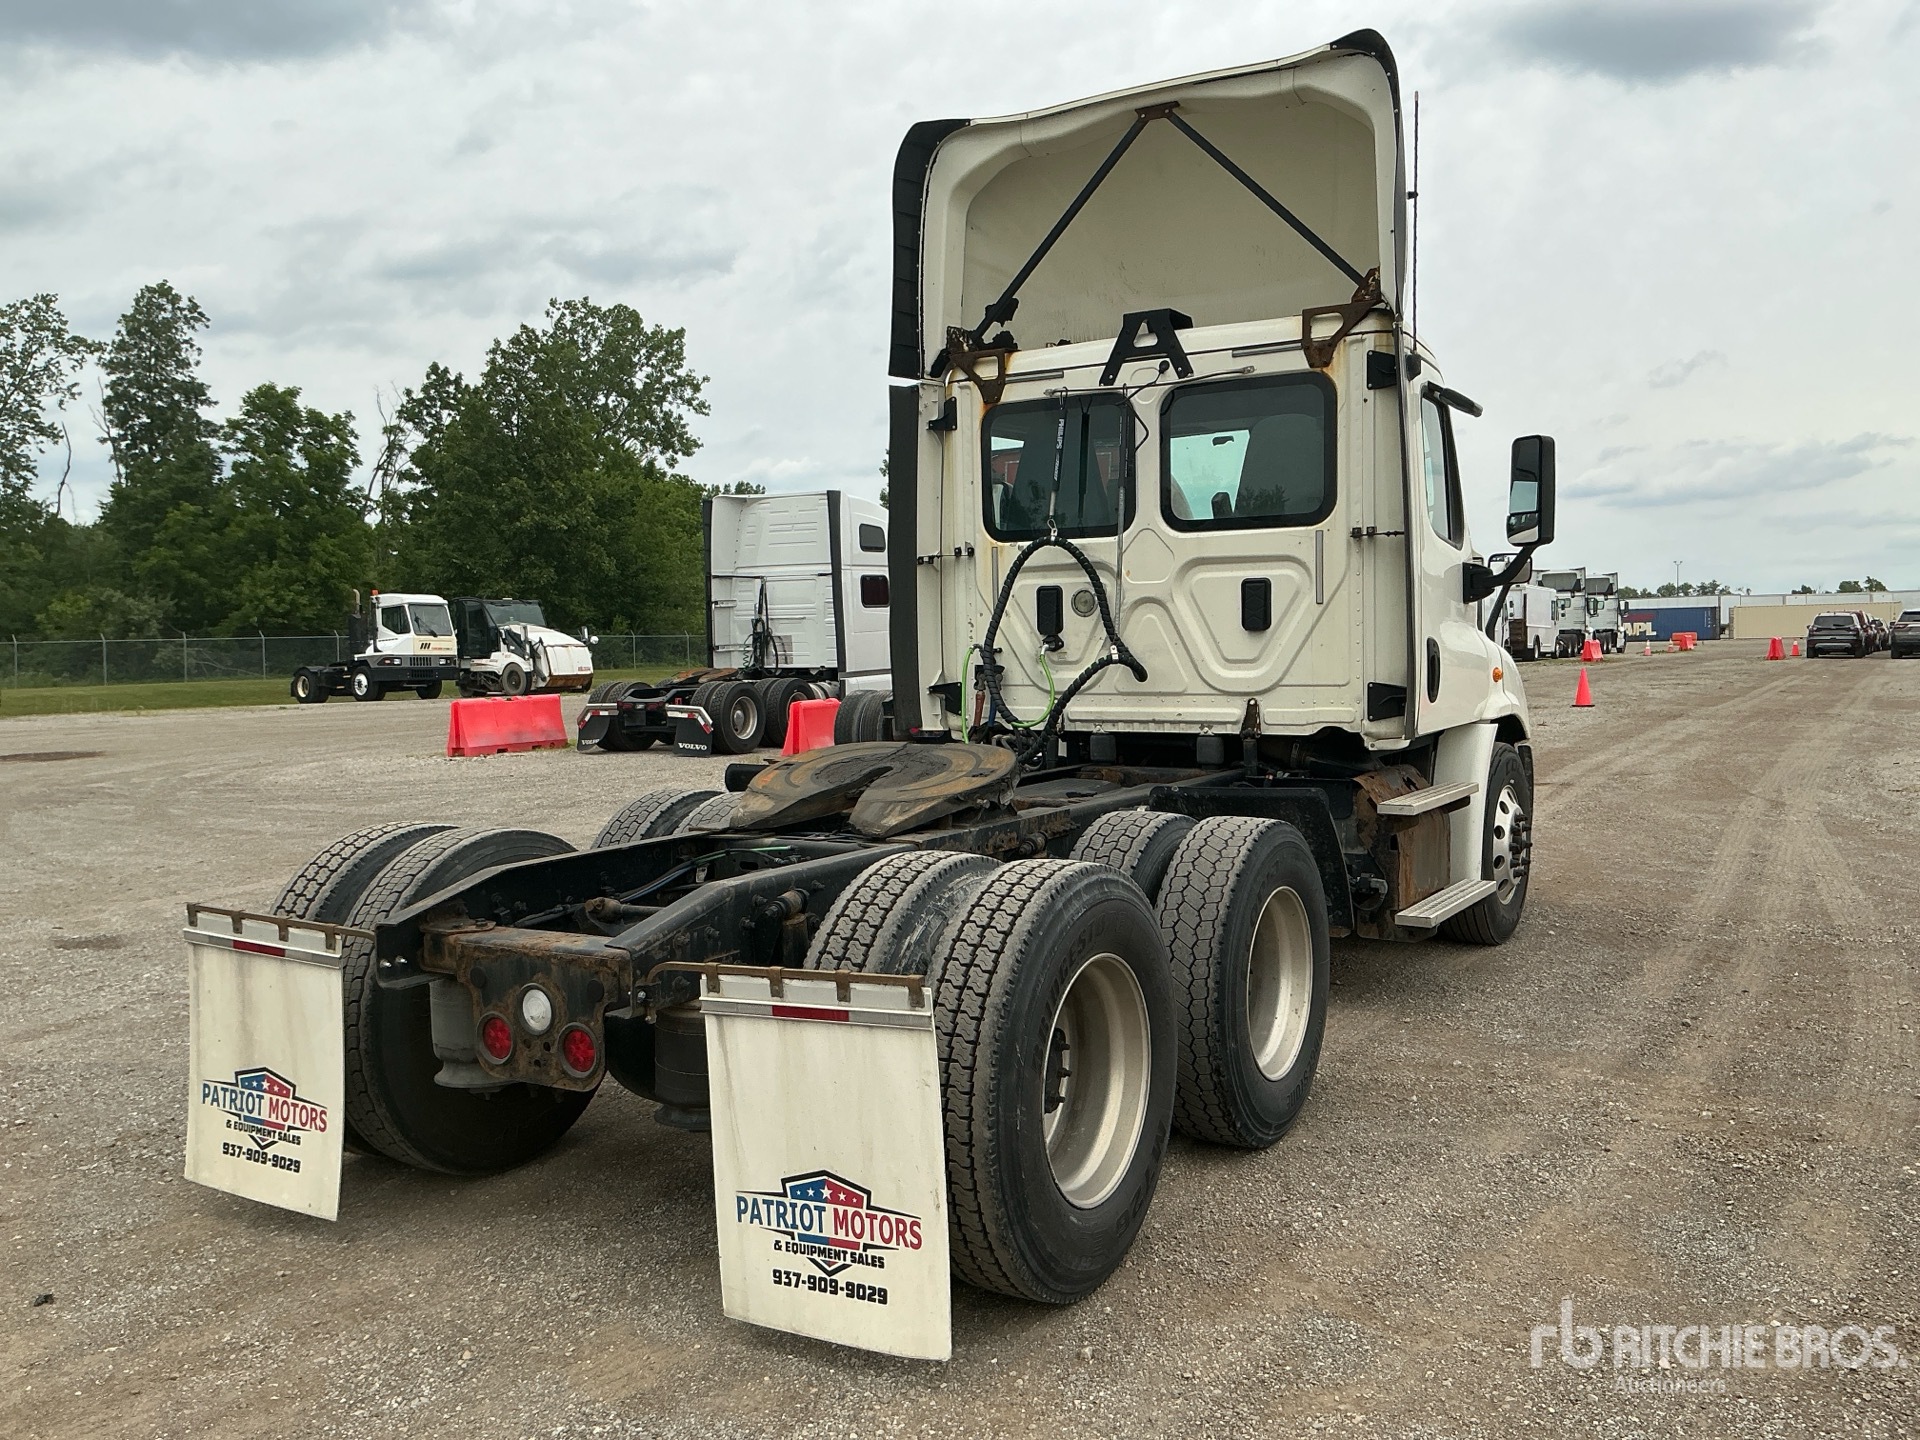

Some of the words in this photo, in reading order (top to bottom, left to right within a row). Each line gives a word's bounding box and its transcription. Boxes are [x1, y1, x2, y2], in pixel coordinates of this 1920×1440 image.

[1056, 418, 1065, 449] PHILLIPS
[1622, 622, 1657, 636] APL
[678, 742, 708, 751] VOLVO
[202, 1083, 264, 1116] PATRIOT
[268, 1096, 328, 1133] MOTORS
[225, 1119, 232, 1129] &
[233, 1120, 277, 1140] EQUIPMENT
[278, 1131, 302, 1146] SALES
[222, 1142, 302, 1173] 937-909-9029
[736, 1195, 826, 1233] PATRIOT
[833, 1207, 923, 1250] MOTORS
[773, 1240, 783, 1251] &
[785, 1241, 848, 1262] EQUIPMENT
[850, 1251, 885, 1269] SALES
[772, 1268, 888, 1305] 937-909-9029
